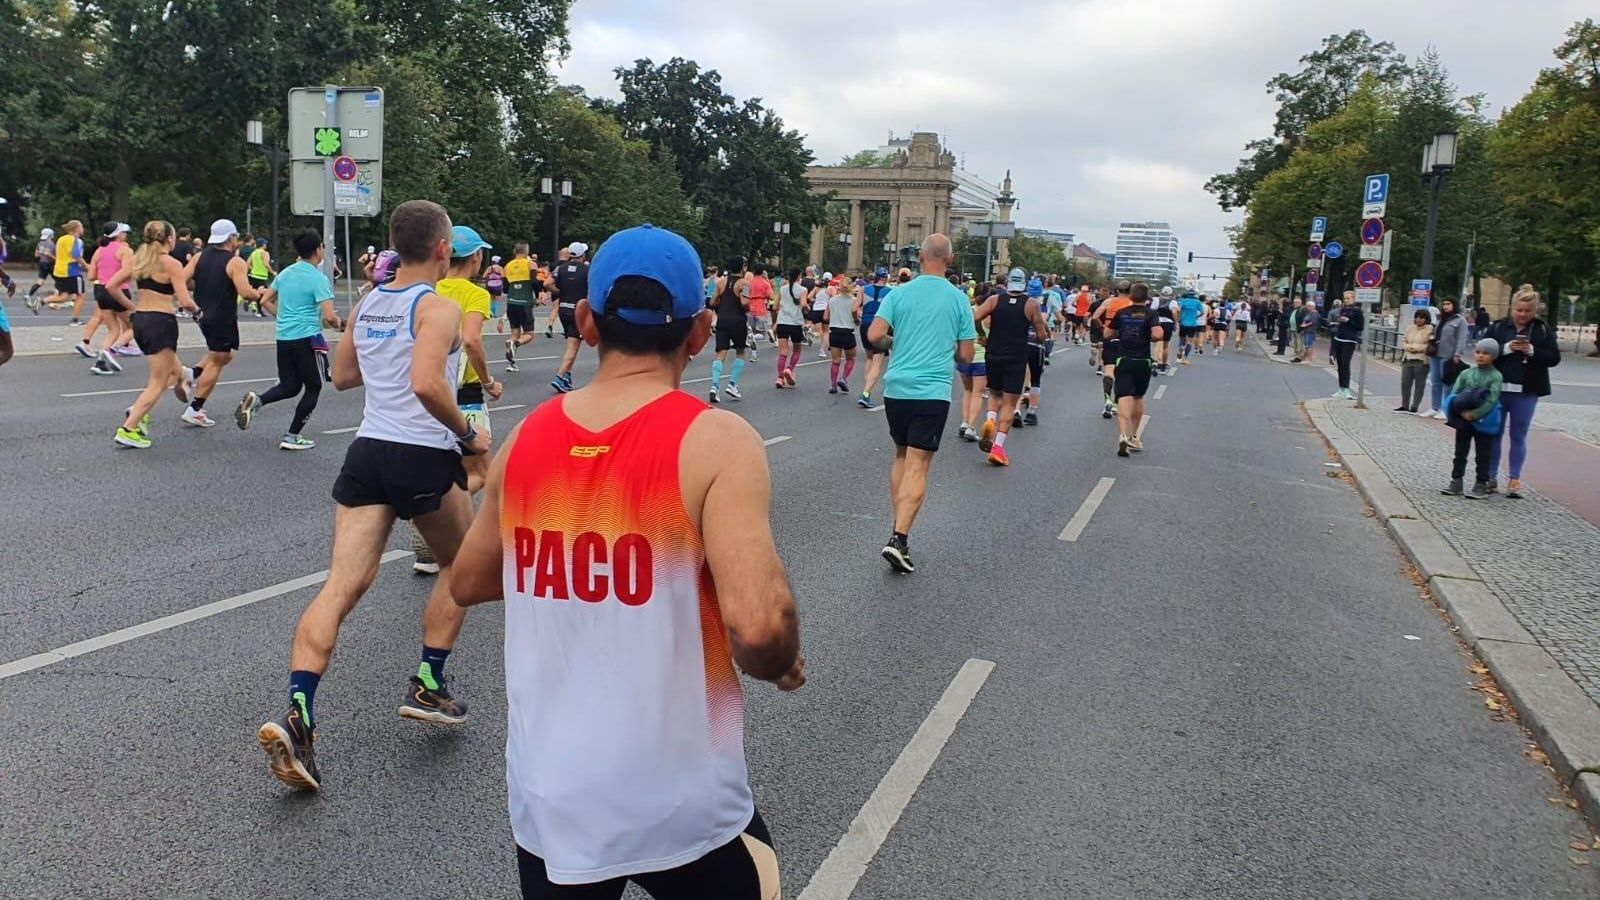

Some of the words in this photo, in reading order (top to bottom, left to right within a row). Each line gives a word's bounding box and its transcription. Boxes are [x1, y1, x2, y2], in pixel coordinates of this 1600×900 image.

[1368, 179, 1382, 200] P
[569, 445, 610, 458] ESP
[515, 528, 653, 606] PACO
